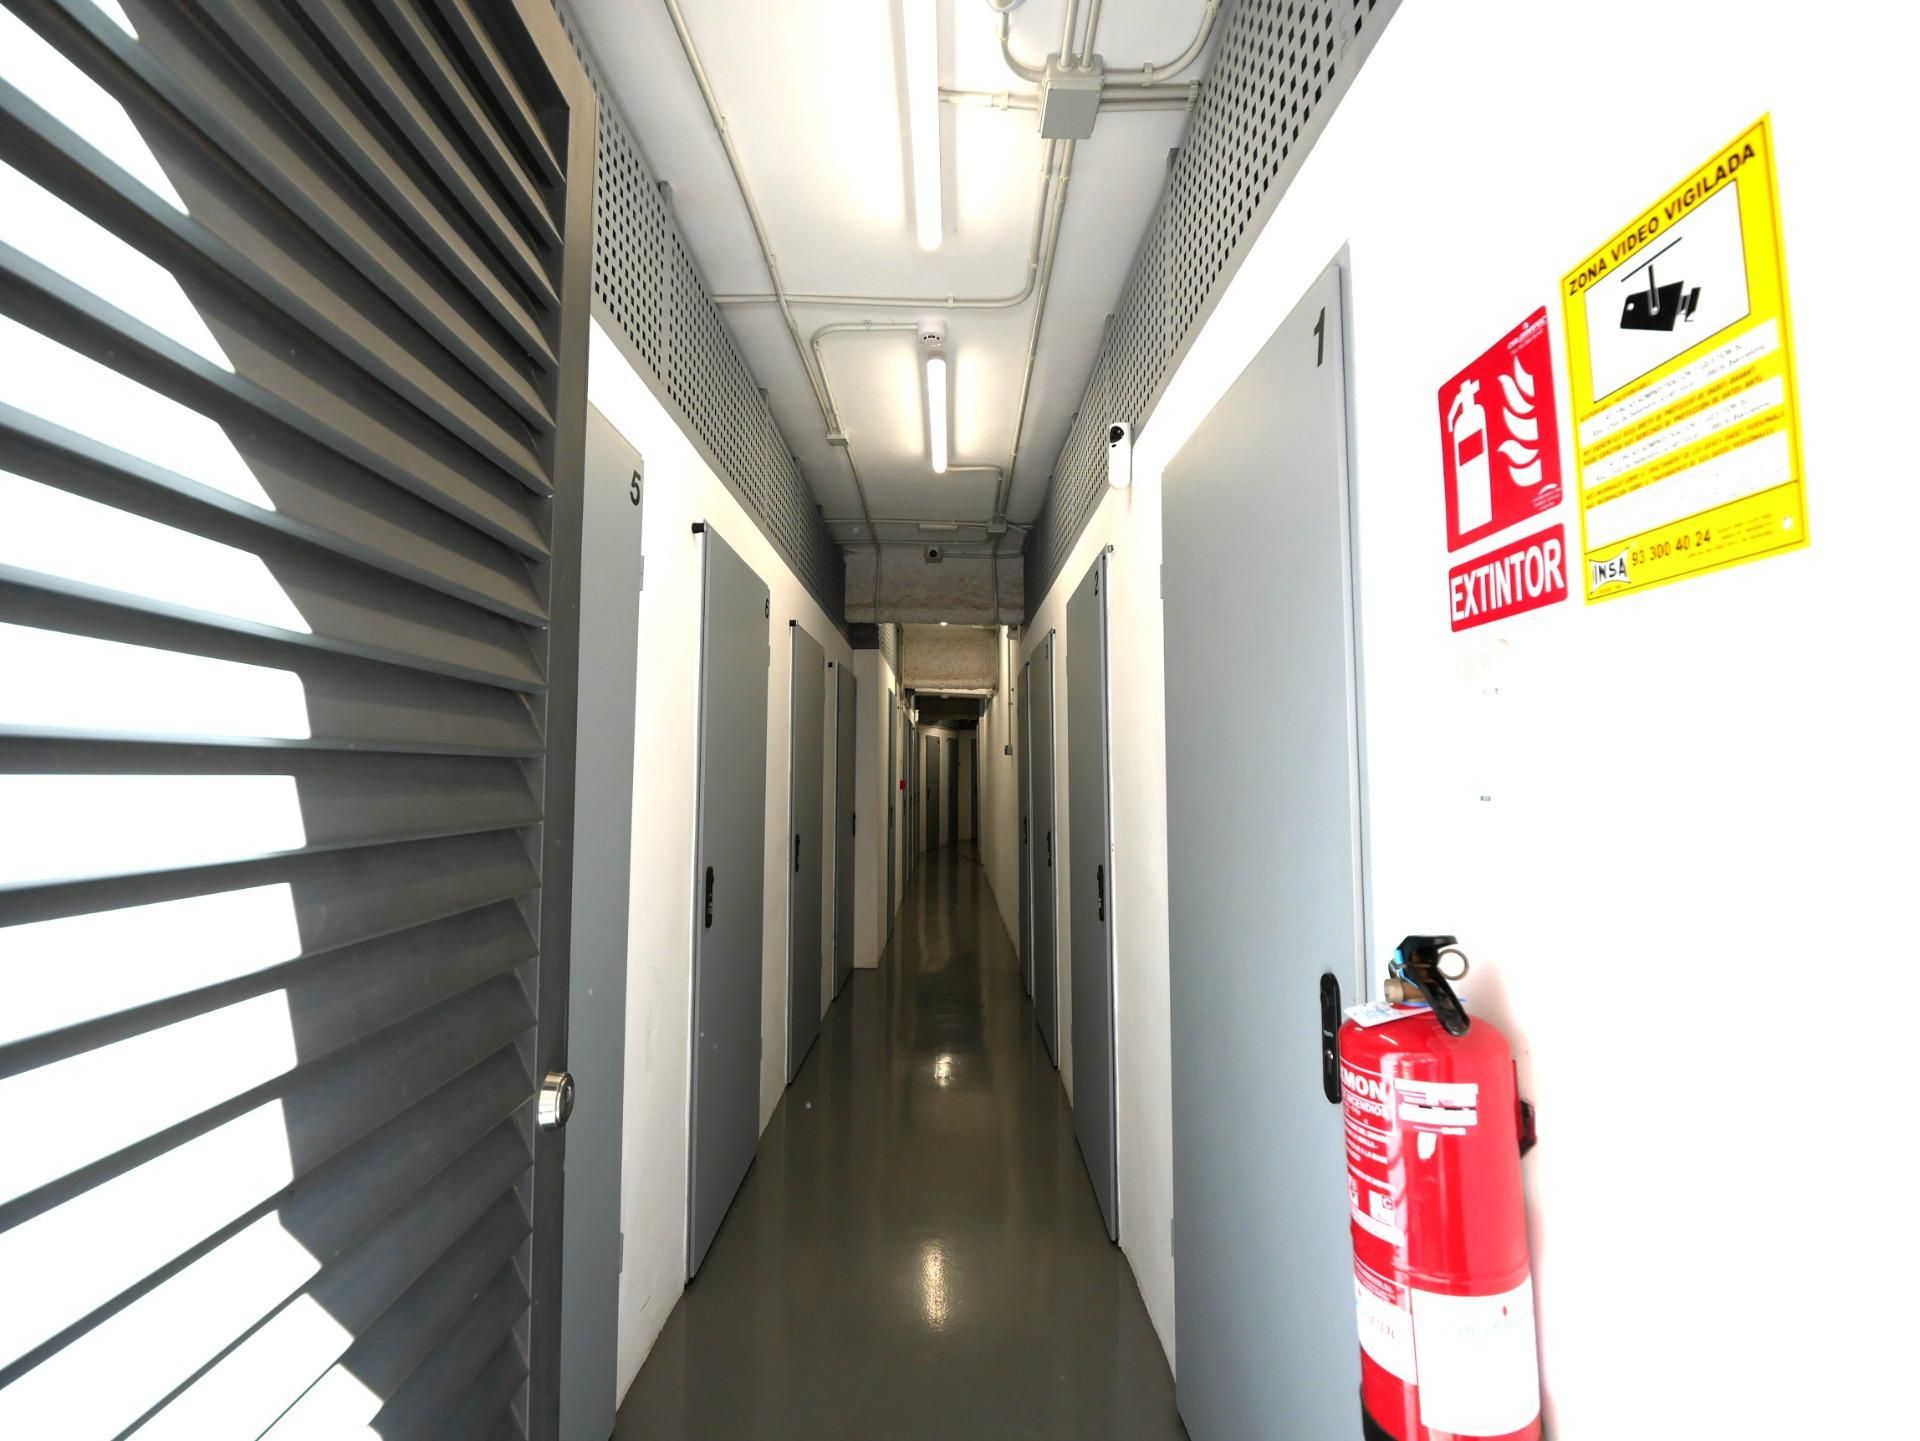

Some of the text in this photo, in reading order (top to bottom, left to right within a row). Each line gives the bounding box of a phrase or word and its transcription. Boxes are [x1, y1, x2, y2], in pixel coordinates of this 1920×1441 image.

[1569, 143, 1756, 296] ZONA VIDEO VIGILADA
[1313, 306, 1326, 368] 1
[629, 470, 642, 506] 5
[1632, 552, 1645, 567] 93
[1650, 541, 1671, 561] 300
[1675, 535, 1691, 552] 40
[1695, 529, 1711, 547] 24
[1093, 570, 1099, 597] 2
[1451, 538, 1565, 622] EXTINTOR
[1594, 557, 1628, 585] INSA
[764, 598, 769, 619] 6
